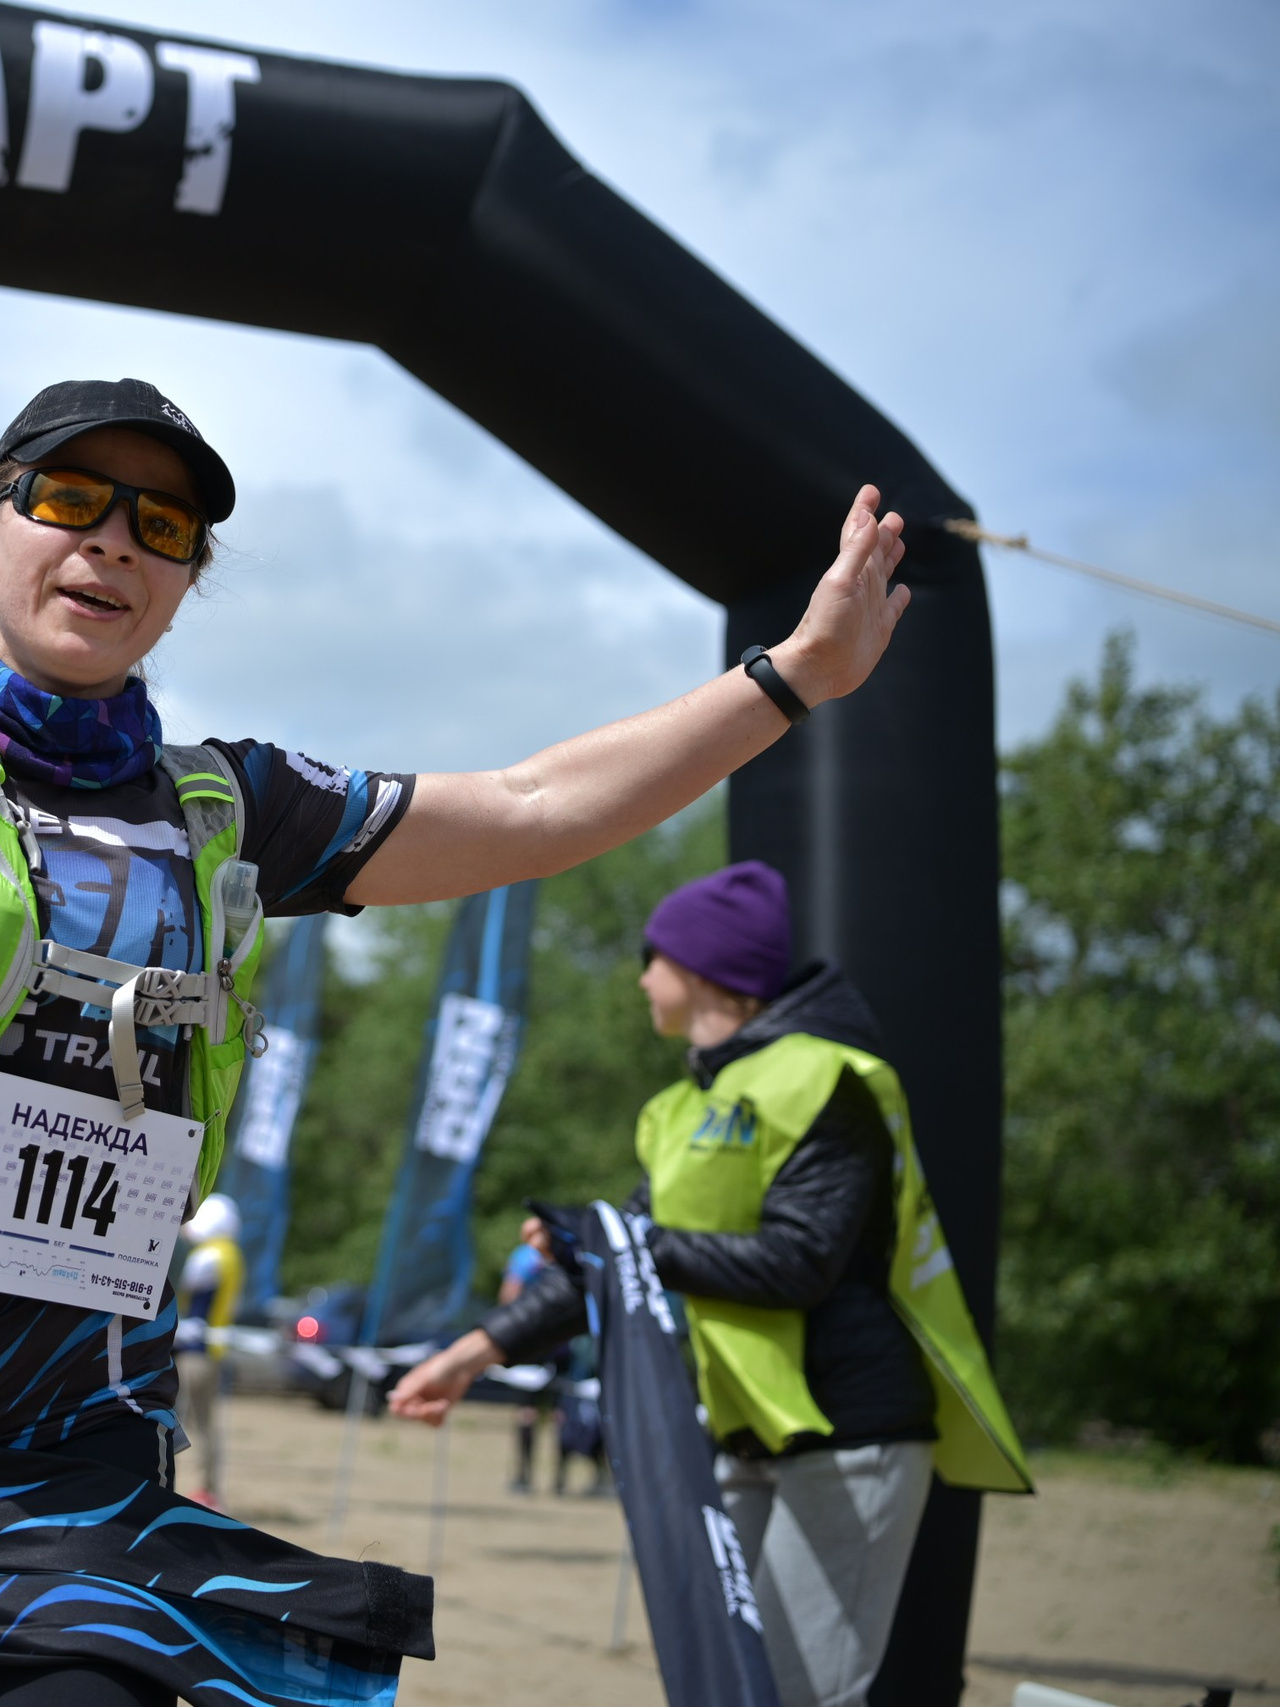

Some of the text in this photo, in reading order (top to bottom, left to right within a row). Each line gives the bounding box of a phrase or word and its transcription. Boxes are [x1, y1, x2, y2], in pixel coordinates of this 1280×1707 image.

[11, 1102, 148, 1156] НАДЕЖДА
[13, 1143, 119, 1237] 1114
[53, 1240, 66, 1248] БЕГ
[117, 1253, 159, 1268] ПОДДЕРЖКА
[90, 1273, 154, 1296] 8-918-515-43-14
